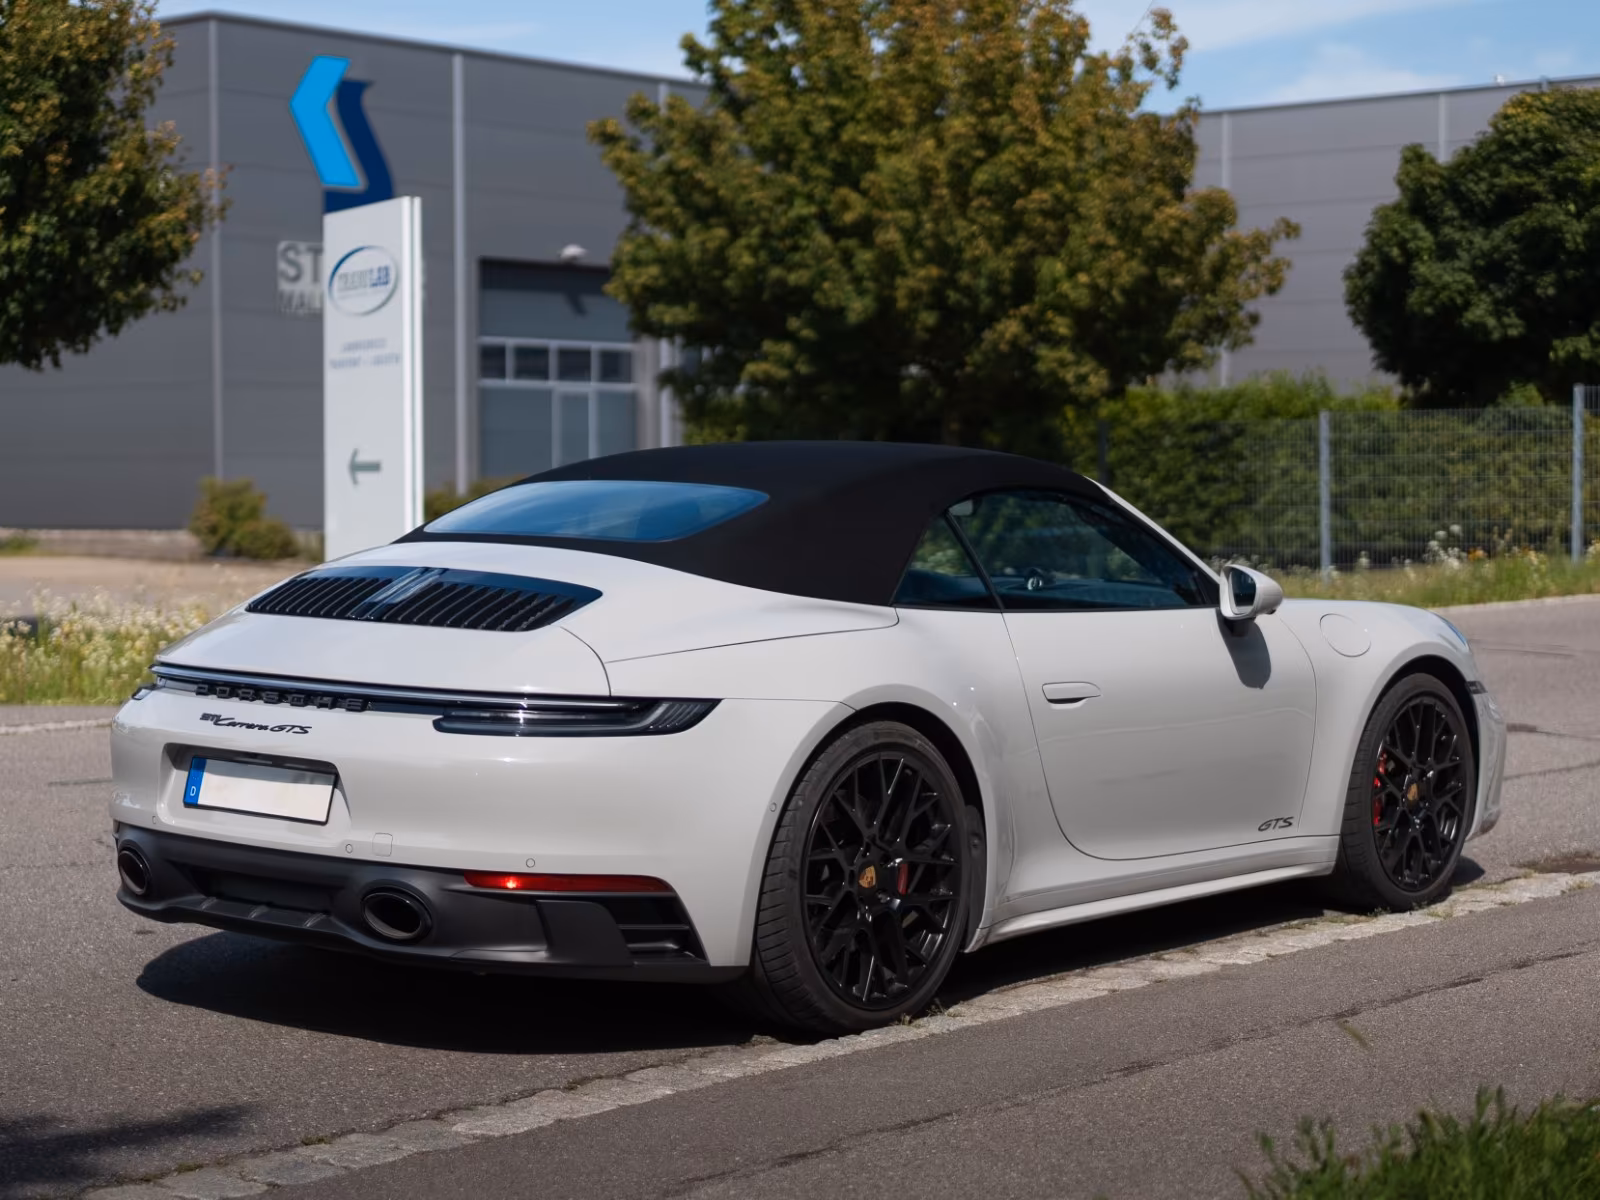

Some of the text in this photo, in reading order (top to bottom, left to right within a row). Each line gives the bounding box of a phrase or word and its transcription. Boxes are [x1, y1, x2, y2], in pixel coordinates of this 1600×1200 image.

[195, 683, 366, 712] PORSCHE
[213, 717, 269, 731] Carrera
[269, 724, 312, 735] GTS
[190, 786, 196, 797] D
[1258, 816, 1294, 831] GTS
